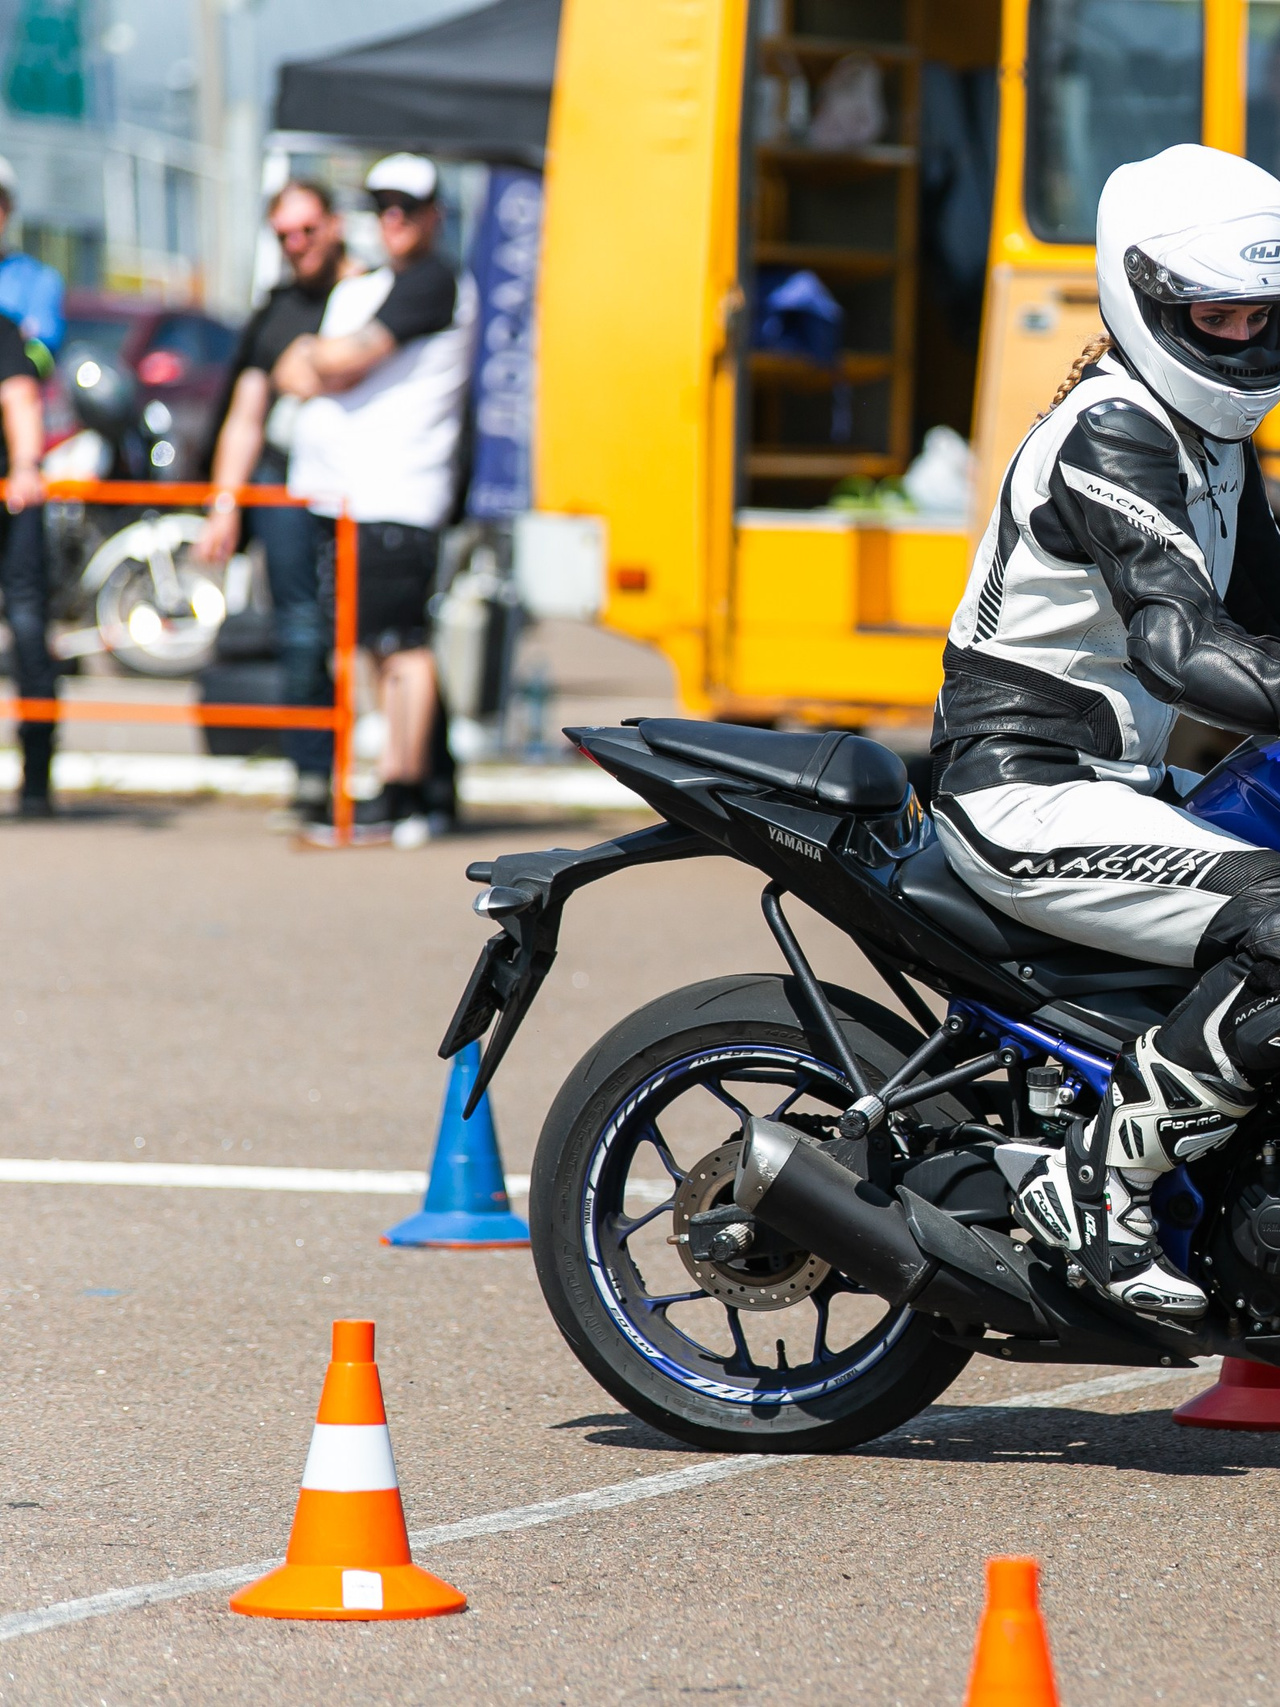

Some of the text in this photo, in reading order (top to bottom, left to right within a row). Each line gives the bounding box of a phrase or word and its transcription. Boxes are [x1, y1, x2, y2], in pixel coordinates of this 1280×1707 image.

[1086, 484, 1156, 524] MACNA
[768, 826, 822, 862] YAMAHA
[1009, 857, 1197, 874] MACNA
[584, 1197, 593, 1225] YAMAHA
[610, 1307, 654, 1354] MT-03
